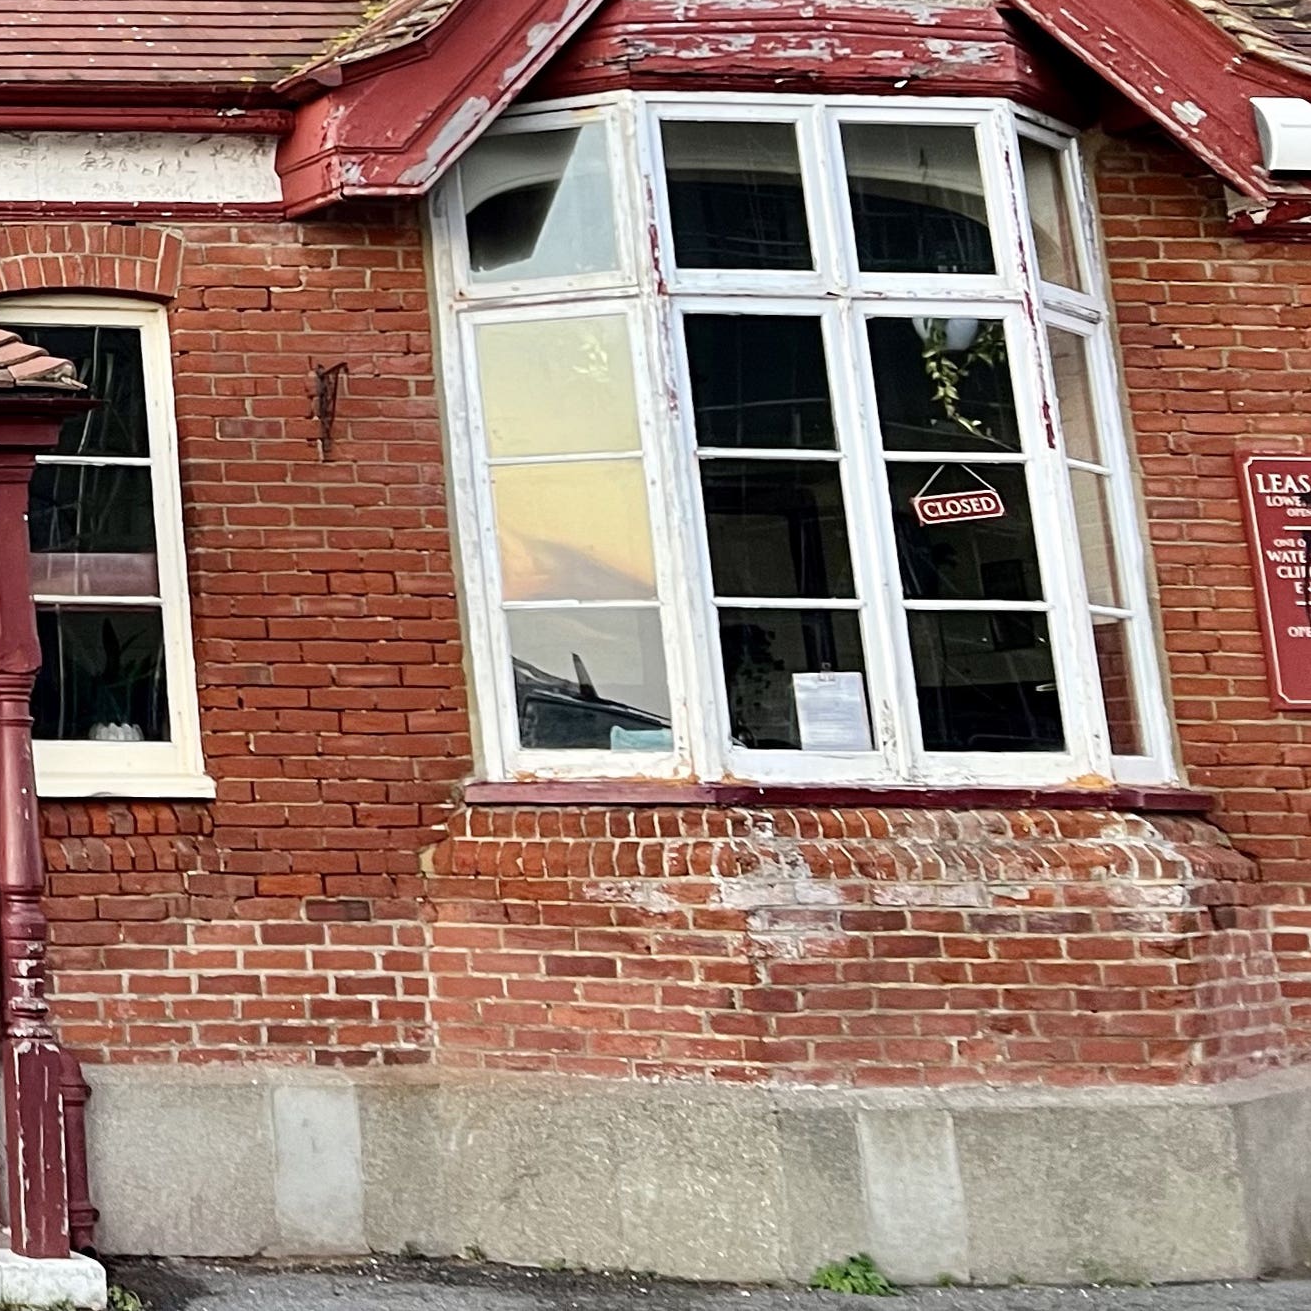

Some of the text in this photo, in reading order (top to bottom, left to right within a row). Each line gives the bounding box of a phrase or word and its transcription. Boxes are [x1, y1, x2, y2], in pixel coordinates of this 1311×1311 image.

[1255, 473, 1311, 494] LEAS
[923, 496, 996, 518] CLOSED
[1265, 495, 1307, 507] LOWE
[1266, 550, 1307, 564] WATE
